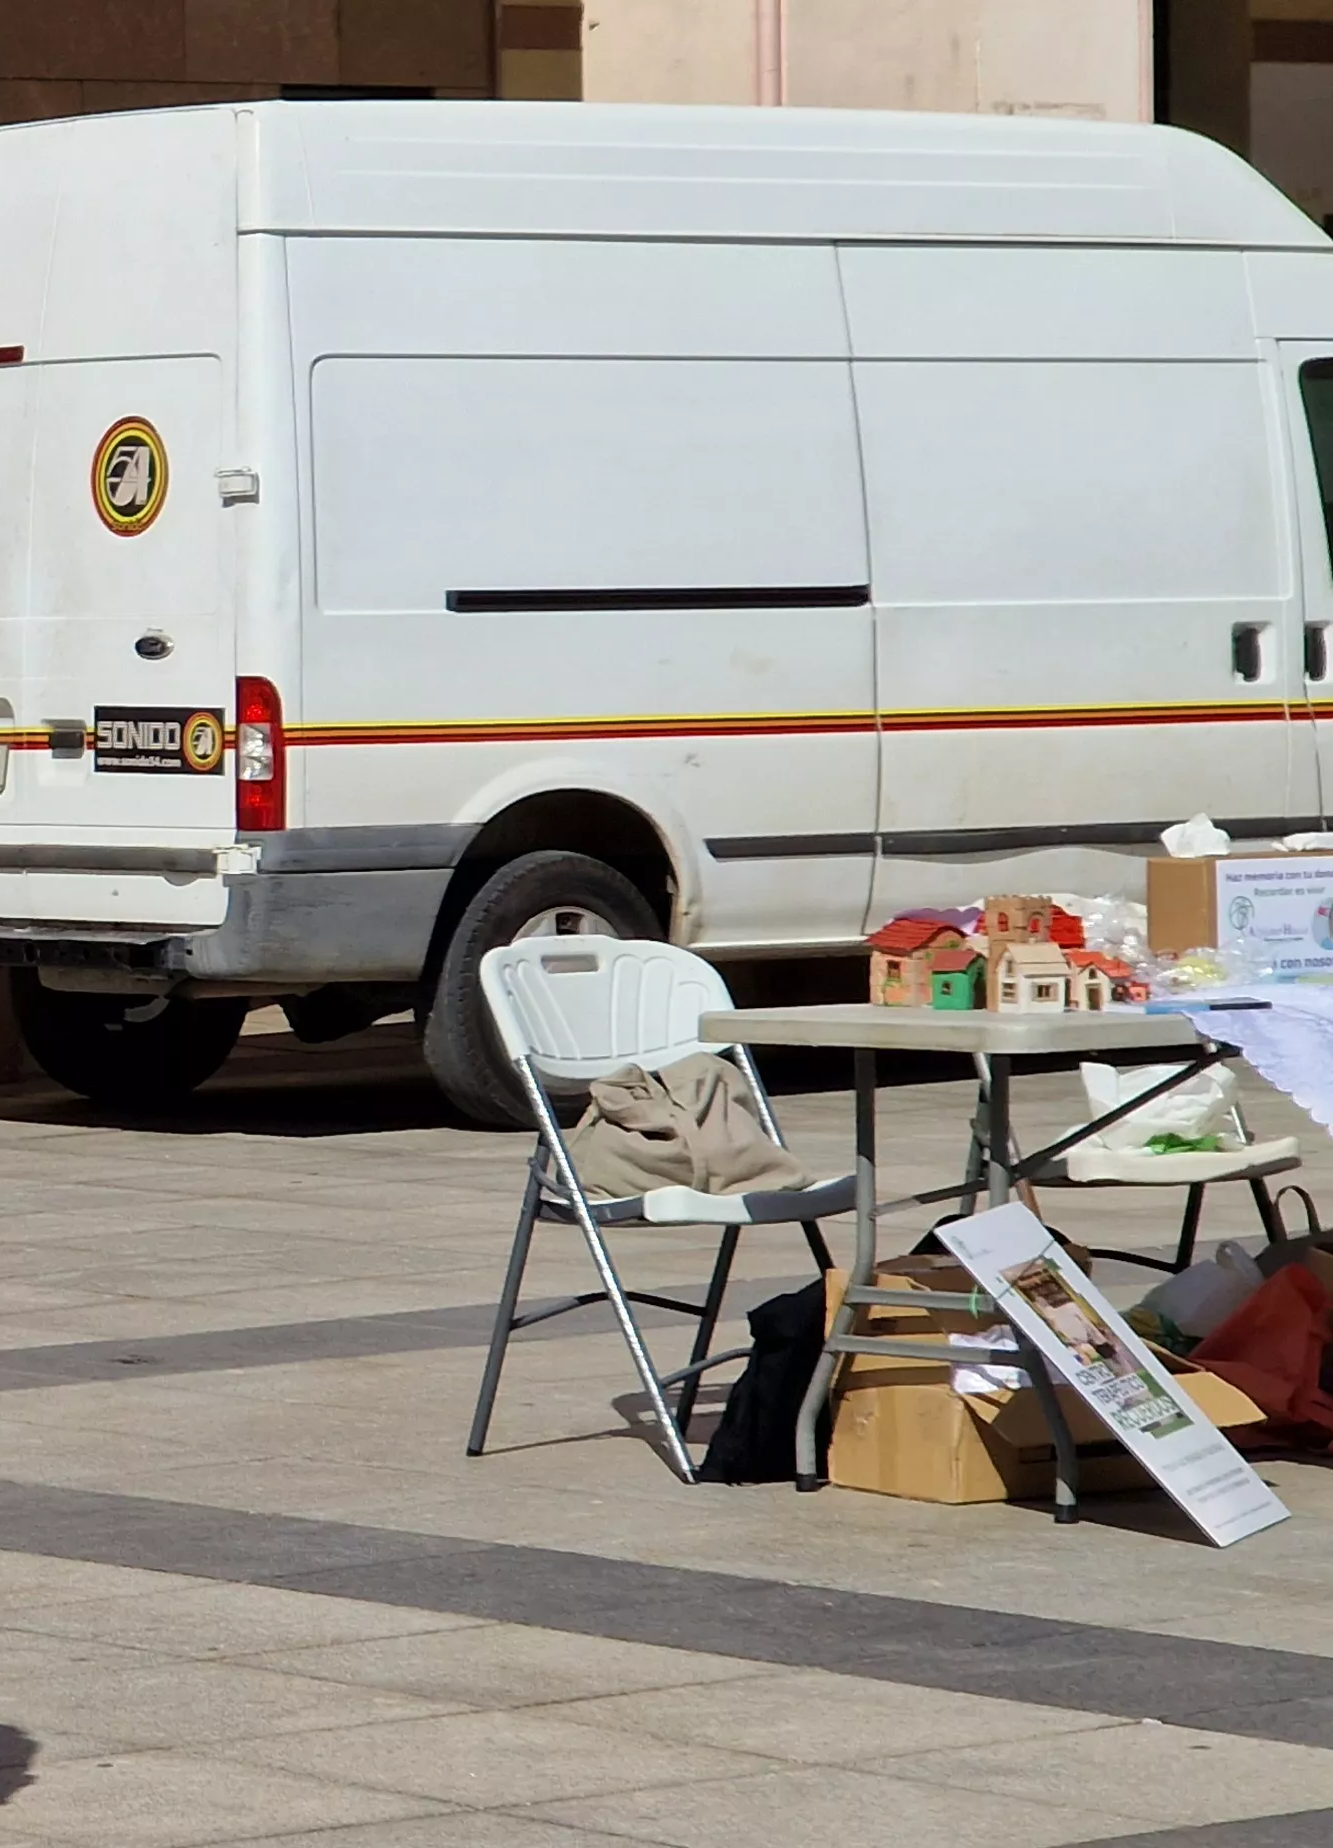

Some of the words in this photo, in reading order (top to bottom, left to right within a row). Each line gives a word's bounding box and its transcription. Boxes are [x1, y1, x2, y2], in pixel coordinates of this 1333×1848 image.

[97, 721, 181, 750] SONIDO
[1244, 871, 1284, 881] memoria
[1286, 872, 1302, 880] con
[1304, 871, 1313, 879] tu
[1280, 958, 1302, 969] con
[1304, 956, 1333, 968] noso
